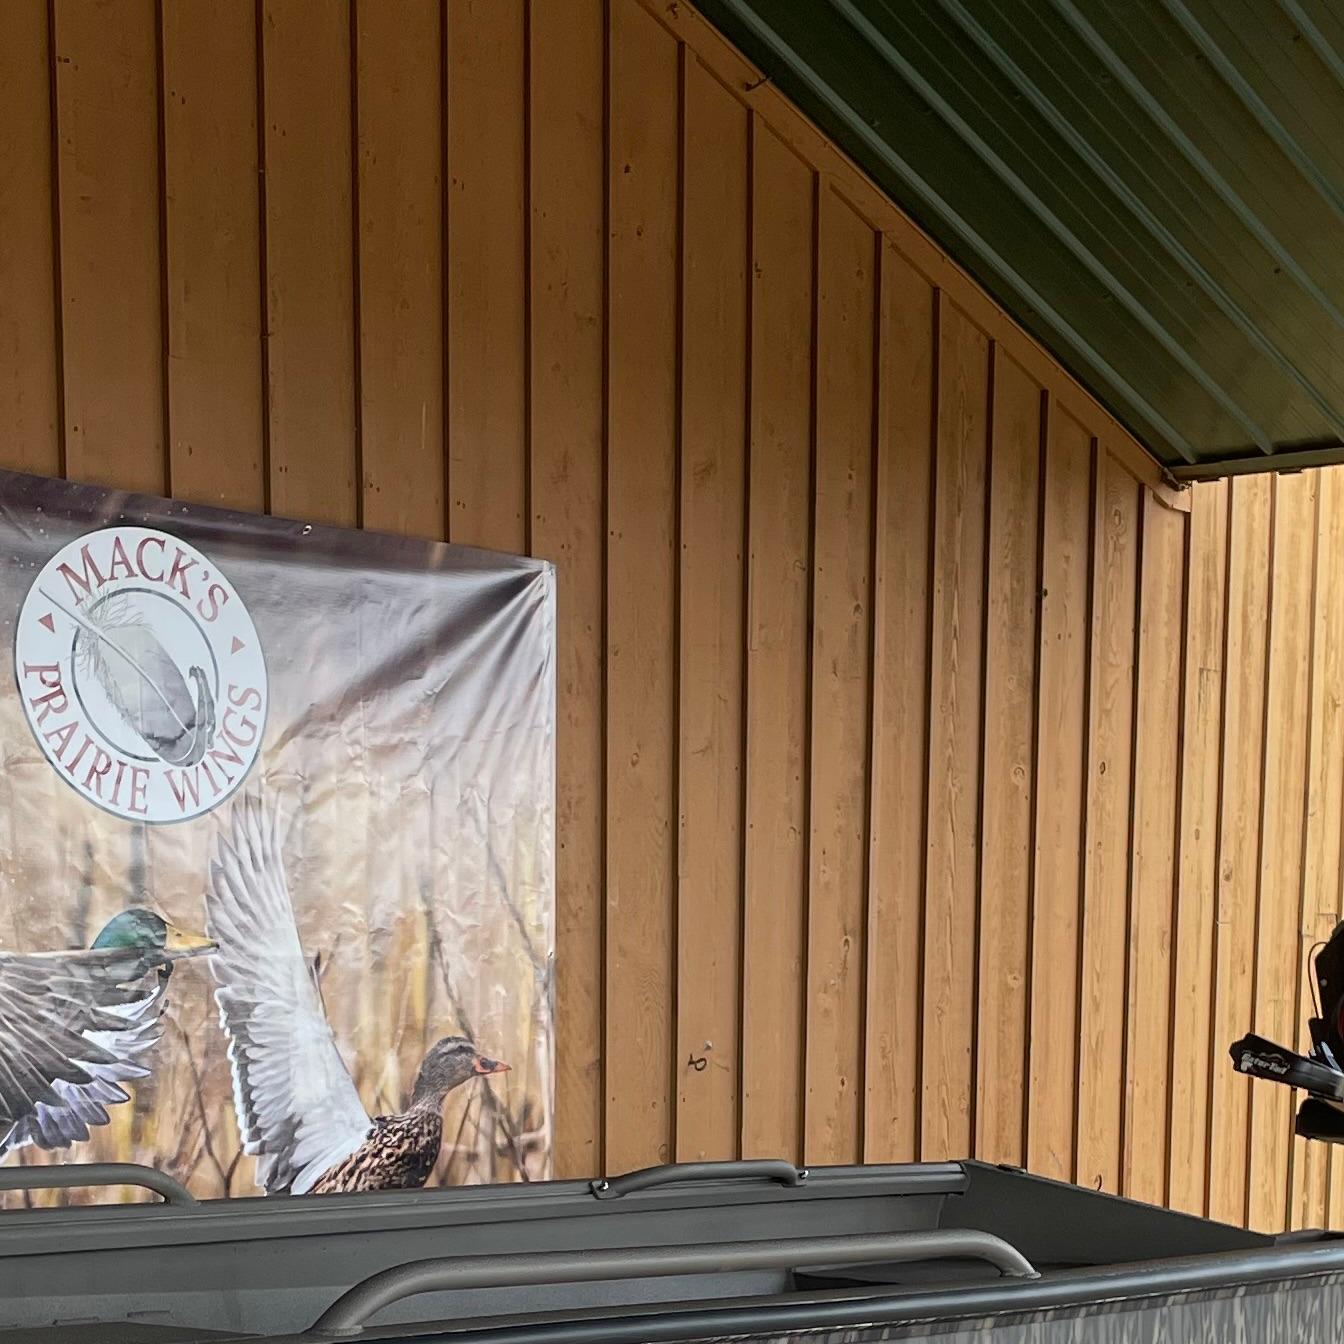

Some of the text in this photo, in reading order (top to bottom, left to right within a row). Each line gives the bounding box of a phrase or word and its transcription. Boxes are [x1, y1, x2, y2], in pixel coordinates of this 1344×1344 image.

[56, 536, 229, 622] MACK'S
[23, 661, 261, 814] PRAIRIE WINGS
